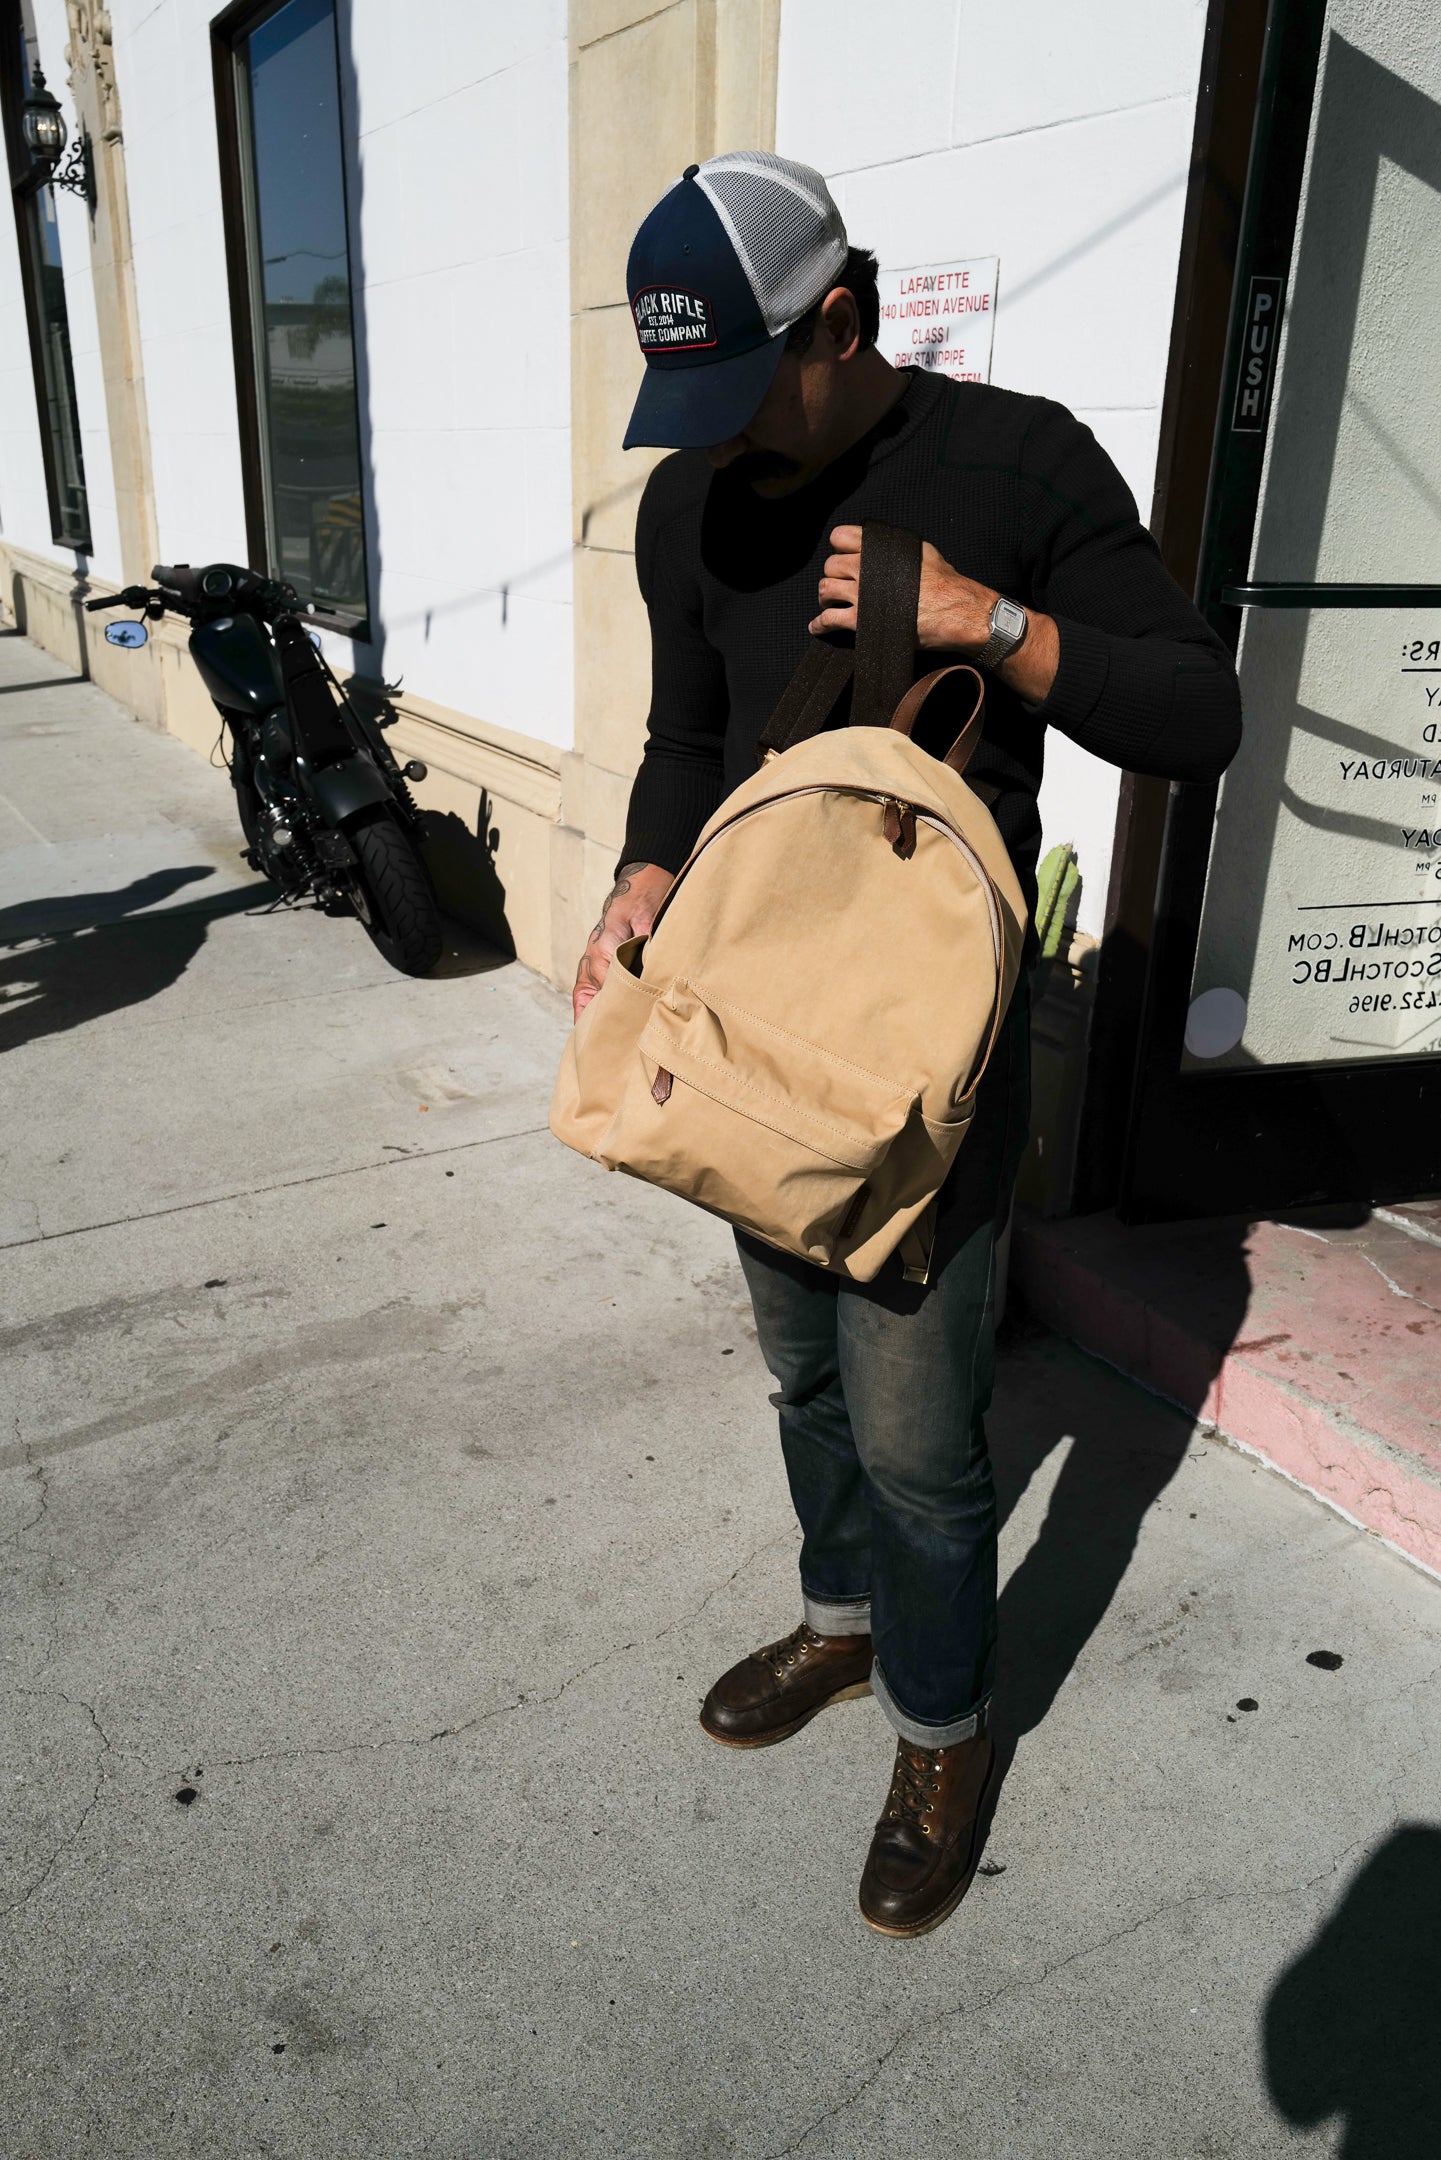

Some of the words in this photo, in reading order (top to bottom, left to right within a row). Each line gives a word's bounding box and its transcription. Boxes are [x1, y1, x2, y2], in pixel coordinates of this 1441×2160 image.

[900, 272, 970, 295] LAFAYETTE
[660, 293, 706, 321] RIFLE
[881, 304, 897, 320] 140
[899, 299, 940, 319] LINDEN
[942, 294, 990, 315] AVENUE
[659, 314, 674, 326] 2014
[657, 323, 707, 342] COMPANY
[911, 326, 944, 345] CLASS
[894, 351, 913, 369] DRY
[914, 348, 965, 368] STANDPIPE
[1240, 293, 1273, 417] PUSH
